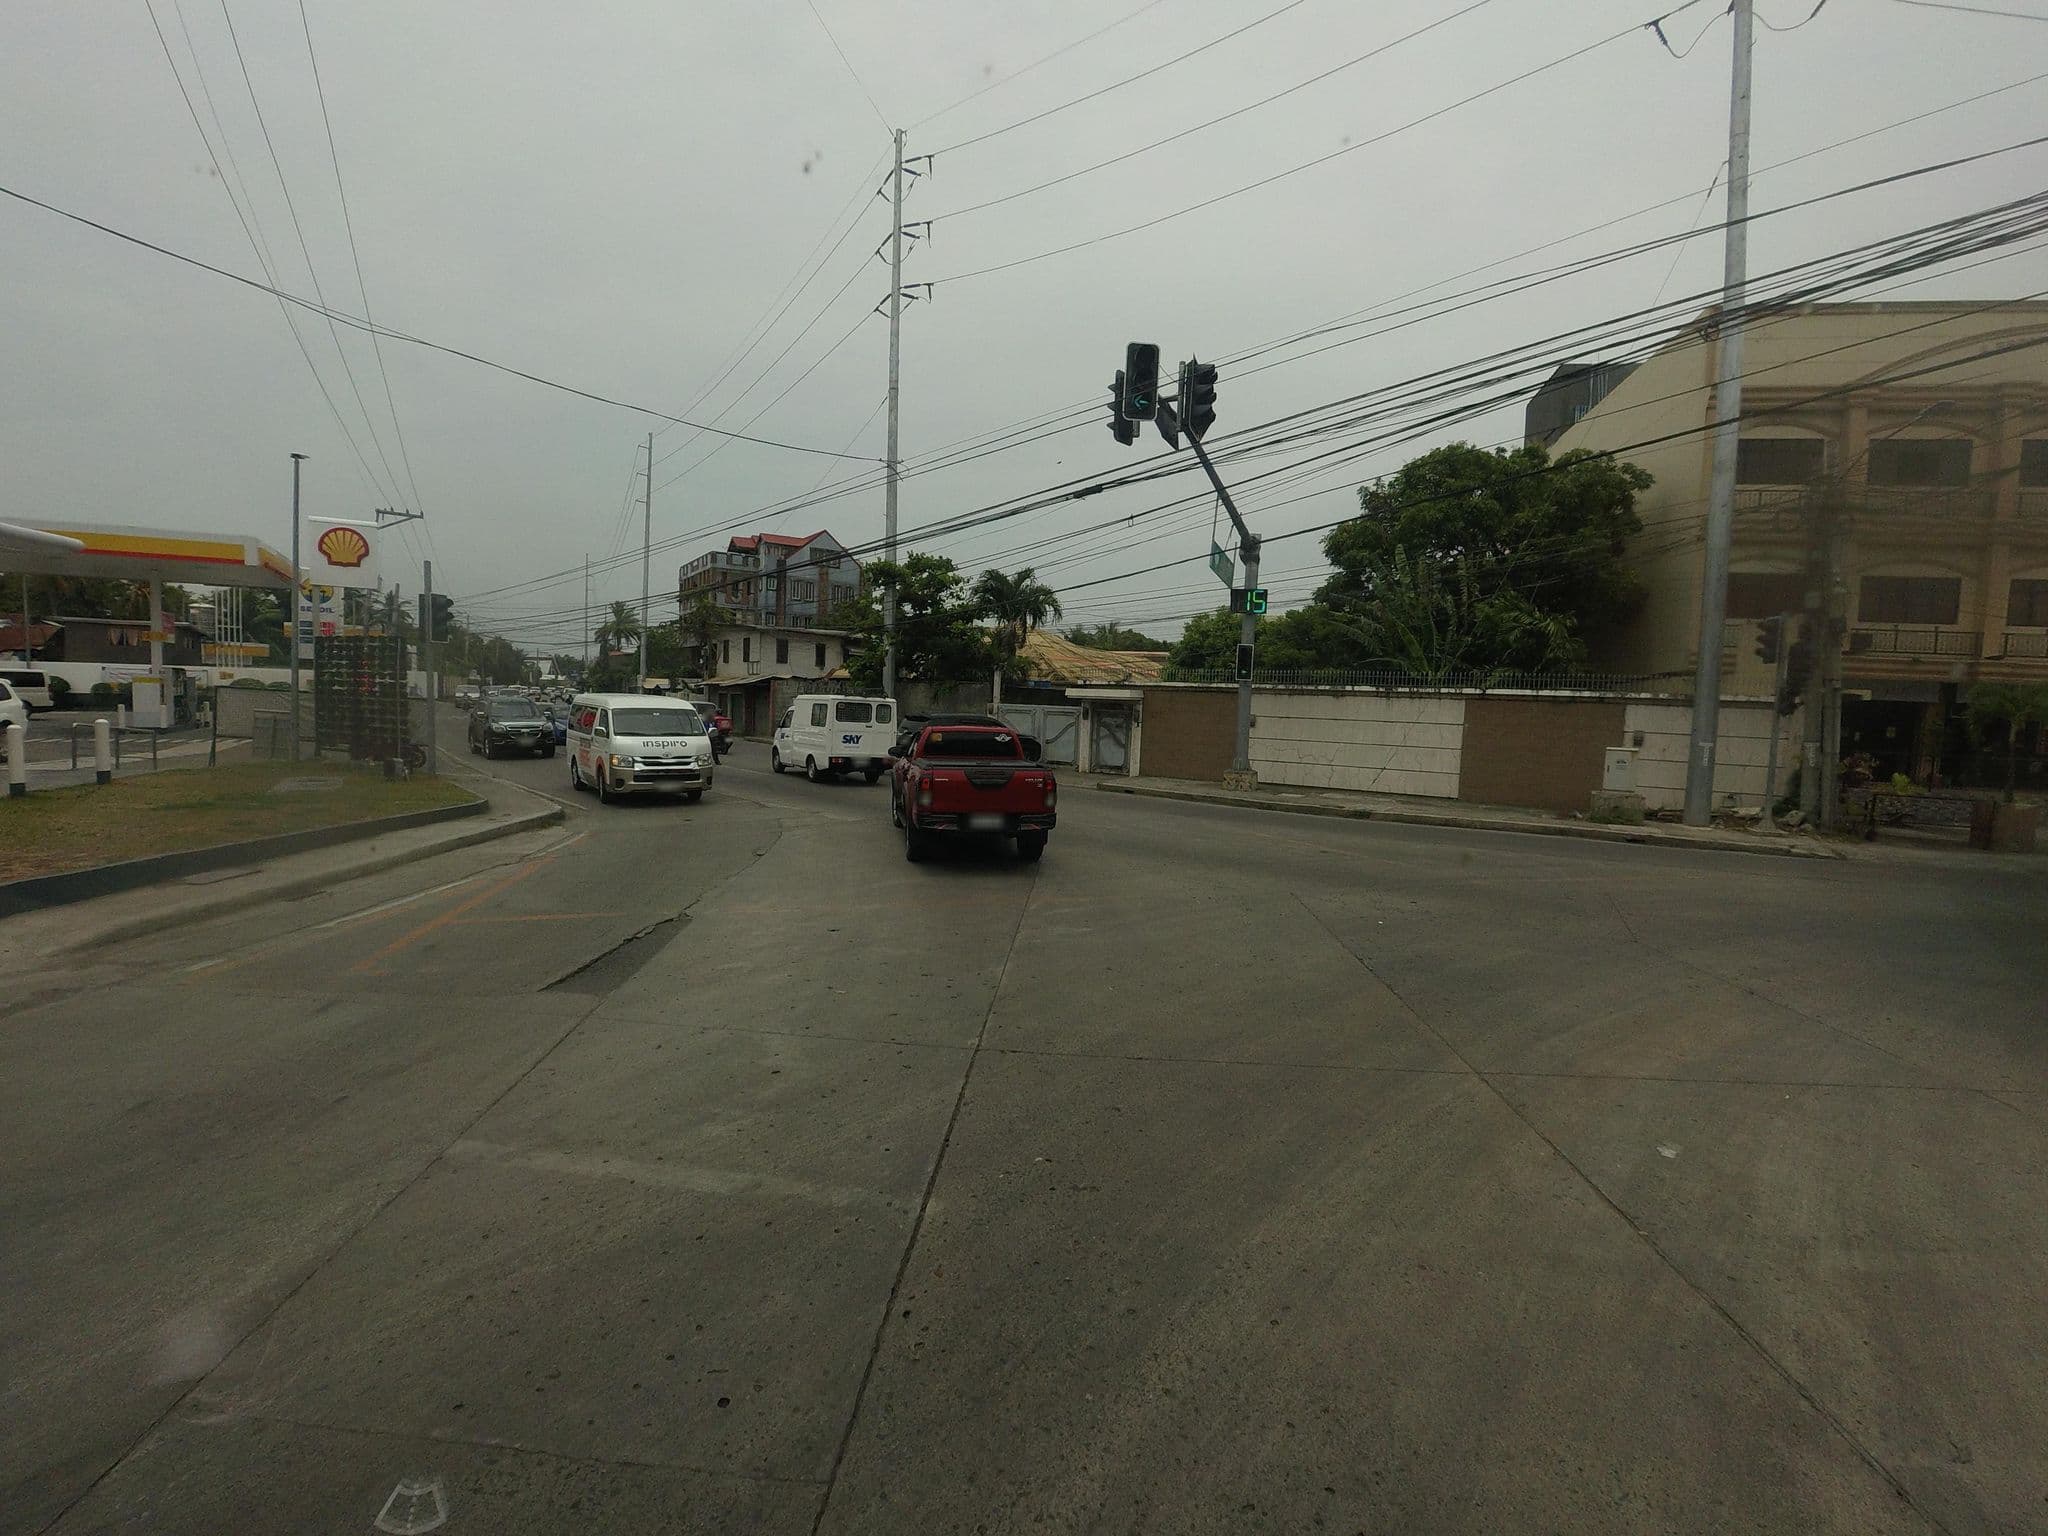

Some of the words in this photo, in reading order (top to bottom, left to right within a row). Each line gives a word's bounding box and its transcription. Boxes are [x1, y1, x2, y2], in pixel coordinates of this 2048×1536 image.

[1246, 590, 1266, 614] 15
[300, 605, 336, 614] SEOIL
[642, 739, 688, 749] inspiro
[842, 734, 862, 745] SKY
